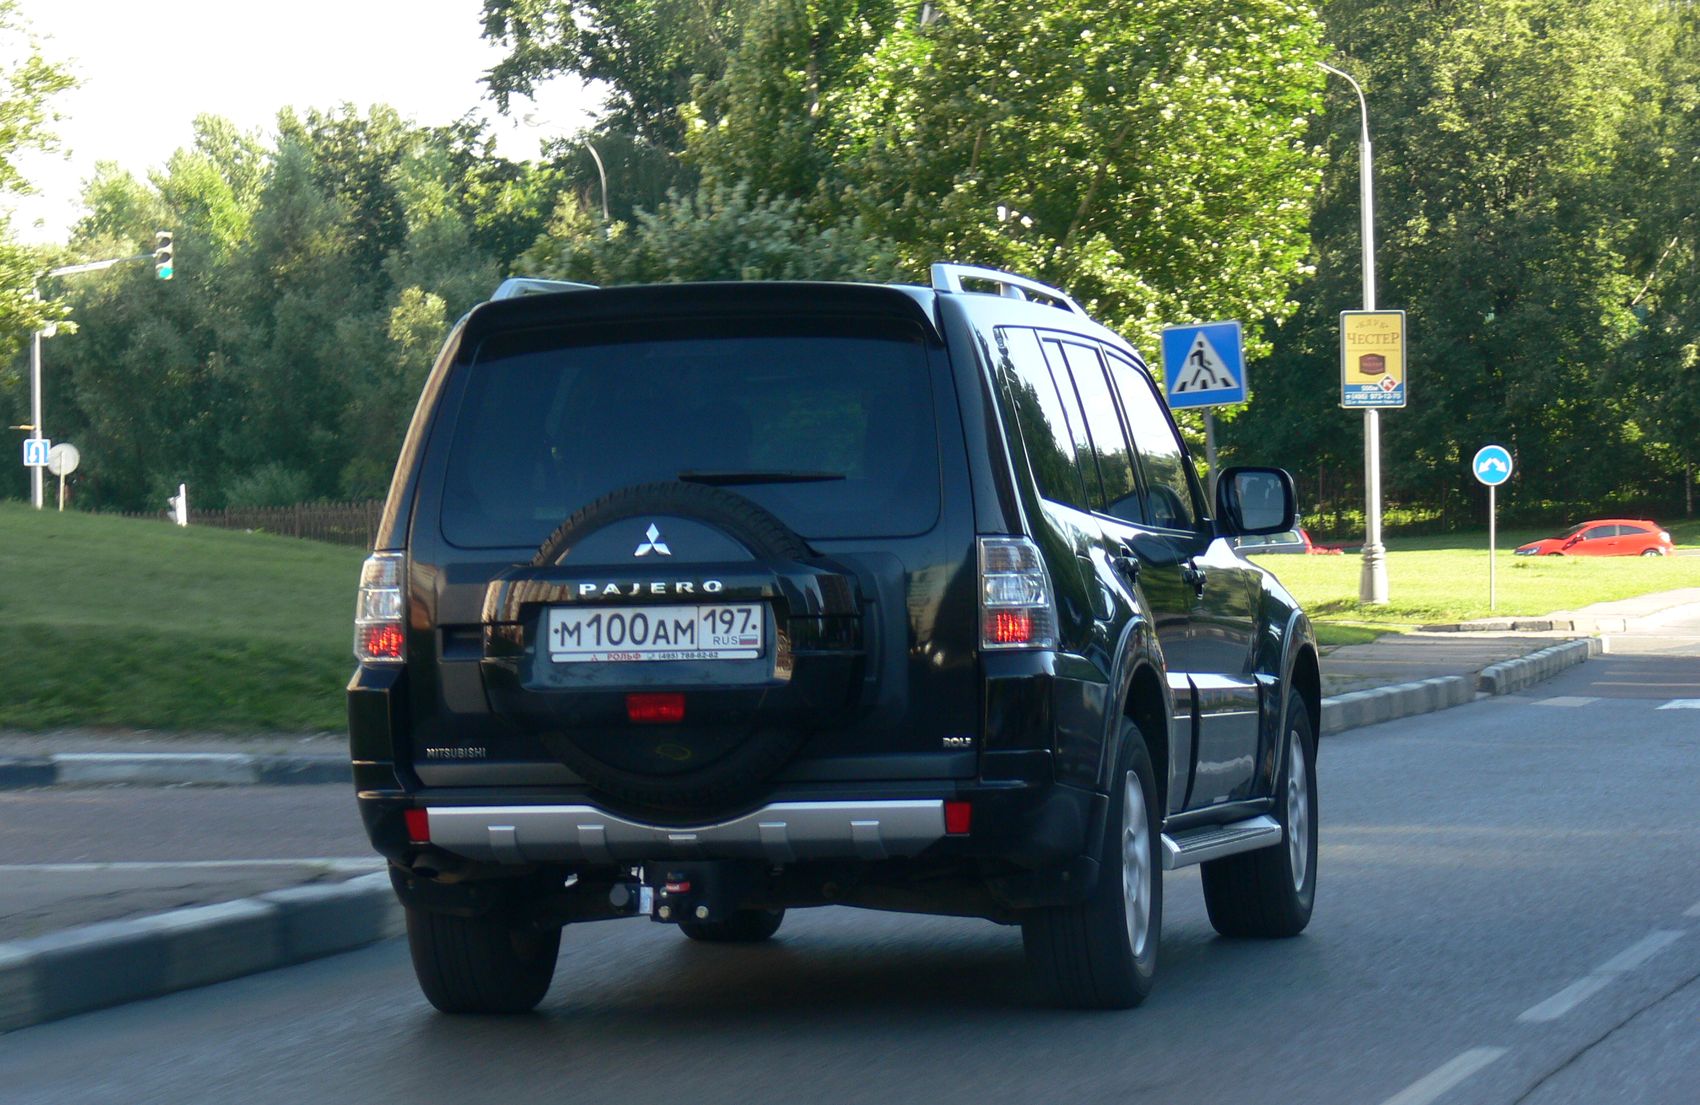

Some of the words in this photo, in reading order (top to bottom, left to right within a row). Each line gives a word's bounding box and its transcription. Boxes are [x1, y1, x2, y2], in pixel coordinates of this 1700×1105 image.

[1347, 332, 1400, 345] ЧЕСТЕР
[579, 580, 723, 595] PAJERO
[703, 608, 752, 635] 197
[713, 636, 738, 645] RUS
[942, 737, 972, 748] ROLF
[426, 747, 486, 758] MITSUBISHI
